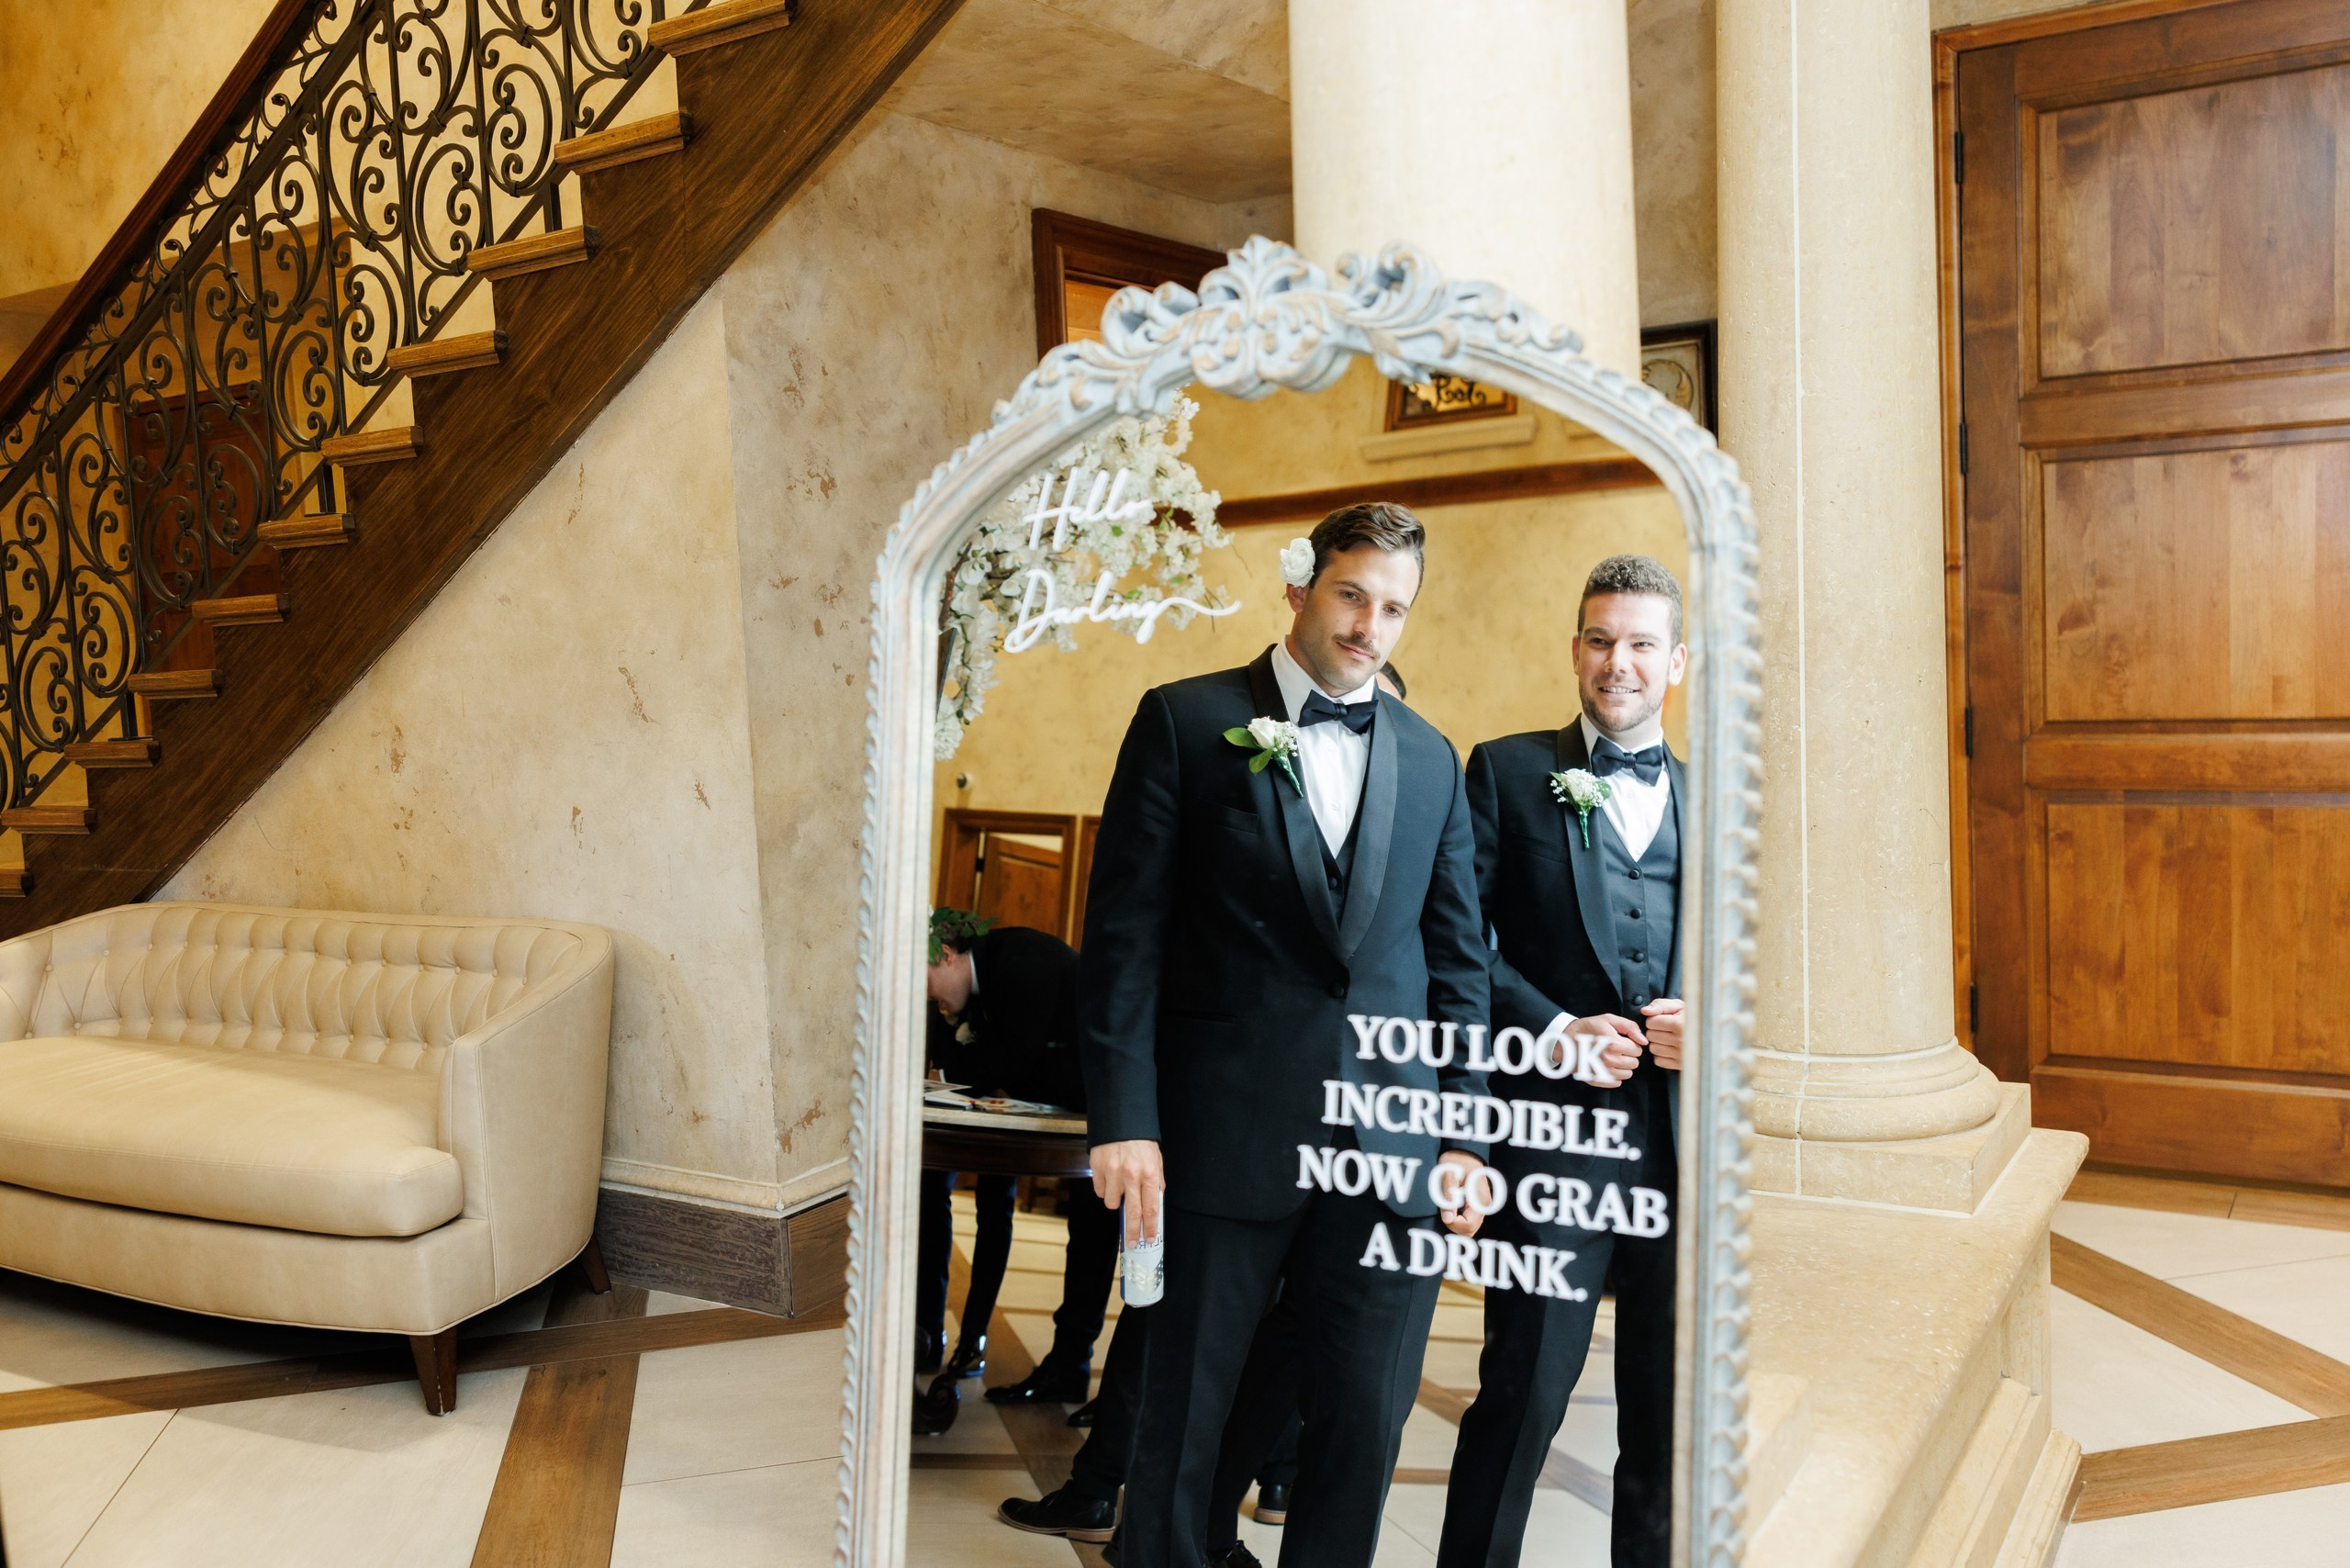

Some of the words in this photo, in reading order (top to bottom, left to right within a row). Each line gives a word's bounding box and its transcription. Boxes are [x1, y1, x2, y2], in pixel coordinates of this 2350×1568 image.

[1023, 465, 1153, 551] Hello
[1003, 568, 1244, 654] Darling
[1347, 1014, 1458, 1069] YOU
[1464, 1024, 1617, 1083] LOOK
[1322, 1079, 1642, 1161] INCREDIBLE.
[1295, 1144, 1422, 1204] NOW
[1427, 1162, 1507, 1215] GO
[1516, 1172, 1670, 1238] GRAB
[1359, 1222, 1401, 1271] A
[1406, 1227, 1589, 1303] DRINK.
